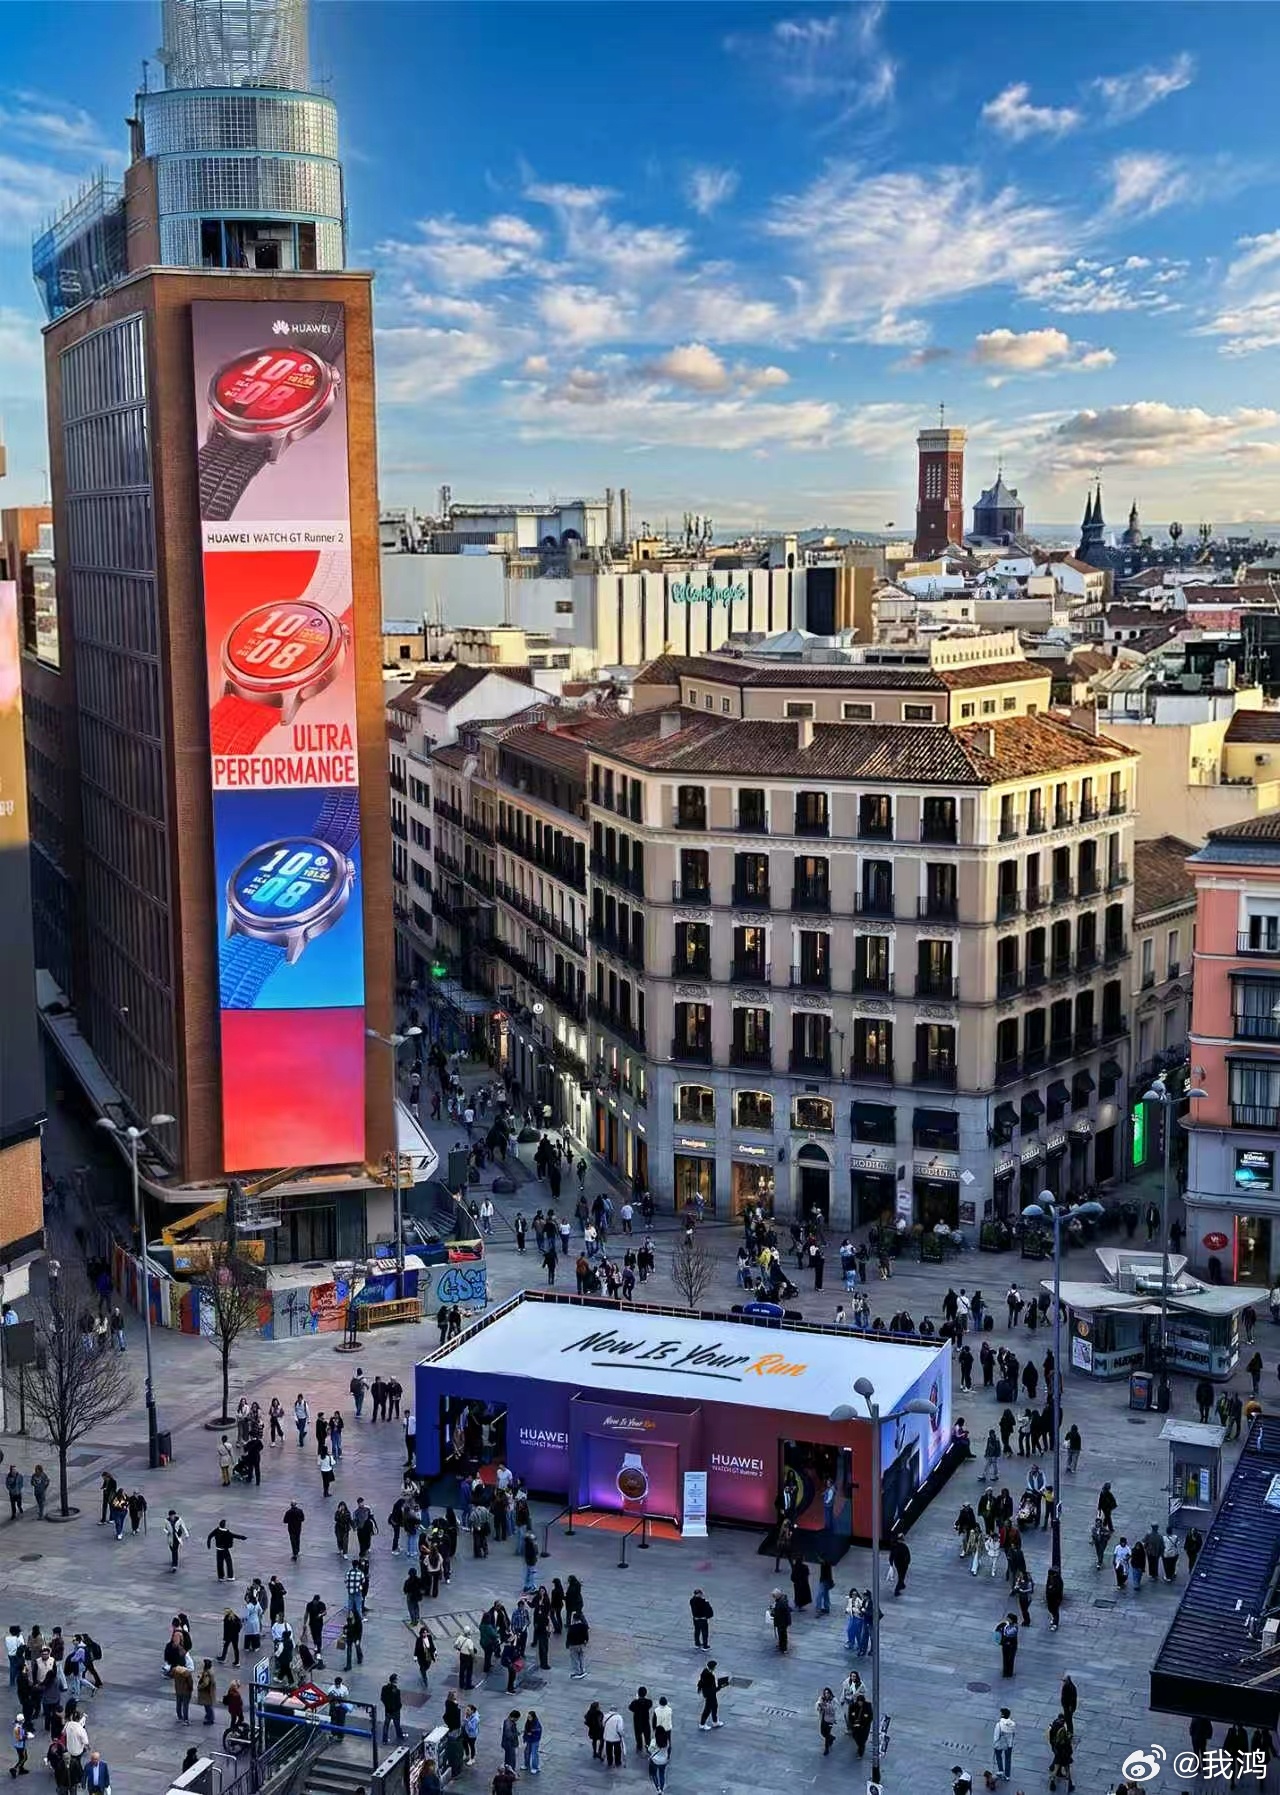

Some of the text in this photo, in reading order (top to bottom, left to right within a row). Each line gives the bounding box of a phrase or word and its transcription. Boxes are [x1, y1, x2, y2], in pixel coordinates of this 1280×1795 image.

[291, 324, 331, 334] HUAWEI
[244, 355, 297, 381] 10
[207, 533, 344, 544] HUAWEI WATCH GT Runner 2
[253, 610, 308, 637] 10
[245, 638, 307, 670] 08
[293, 724, 353, 752] ULTRA
[214, 755, 356, 786] PERFORMANCE
[260, 848, 313, 876] 10
[251, 876, 312, 908] 08
[561, 1329, 809, 1377] Now Is Your Run
[602, 1415, 620, 1426] Now
[627, 1418, 644, 1427] Your
[519, 1427, 569, 1444] HUAWEI
[520, 1438, 539, 1447] WATCH
[546, 1442, 564, 1450] Runner
[711, 1453, 764, 1470] HUAWEI
[712, 1465, 732, 1473] WATCH
